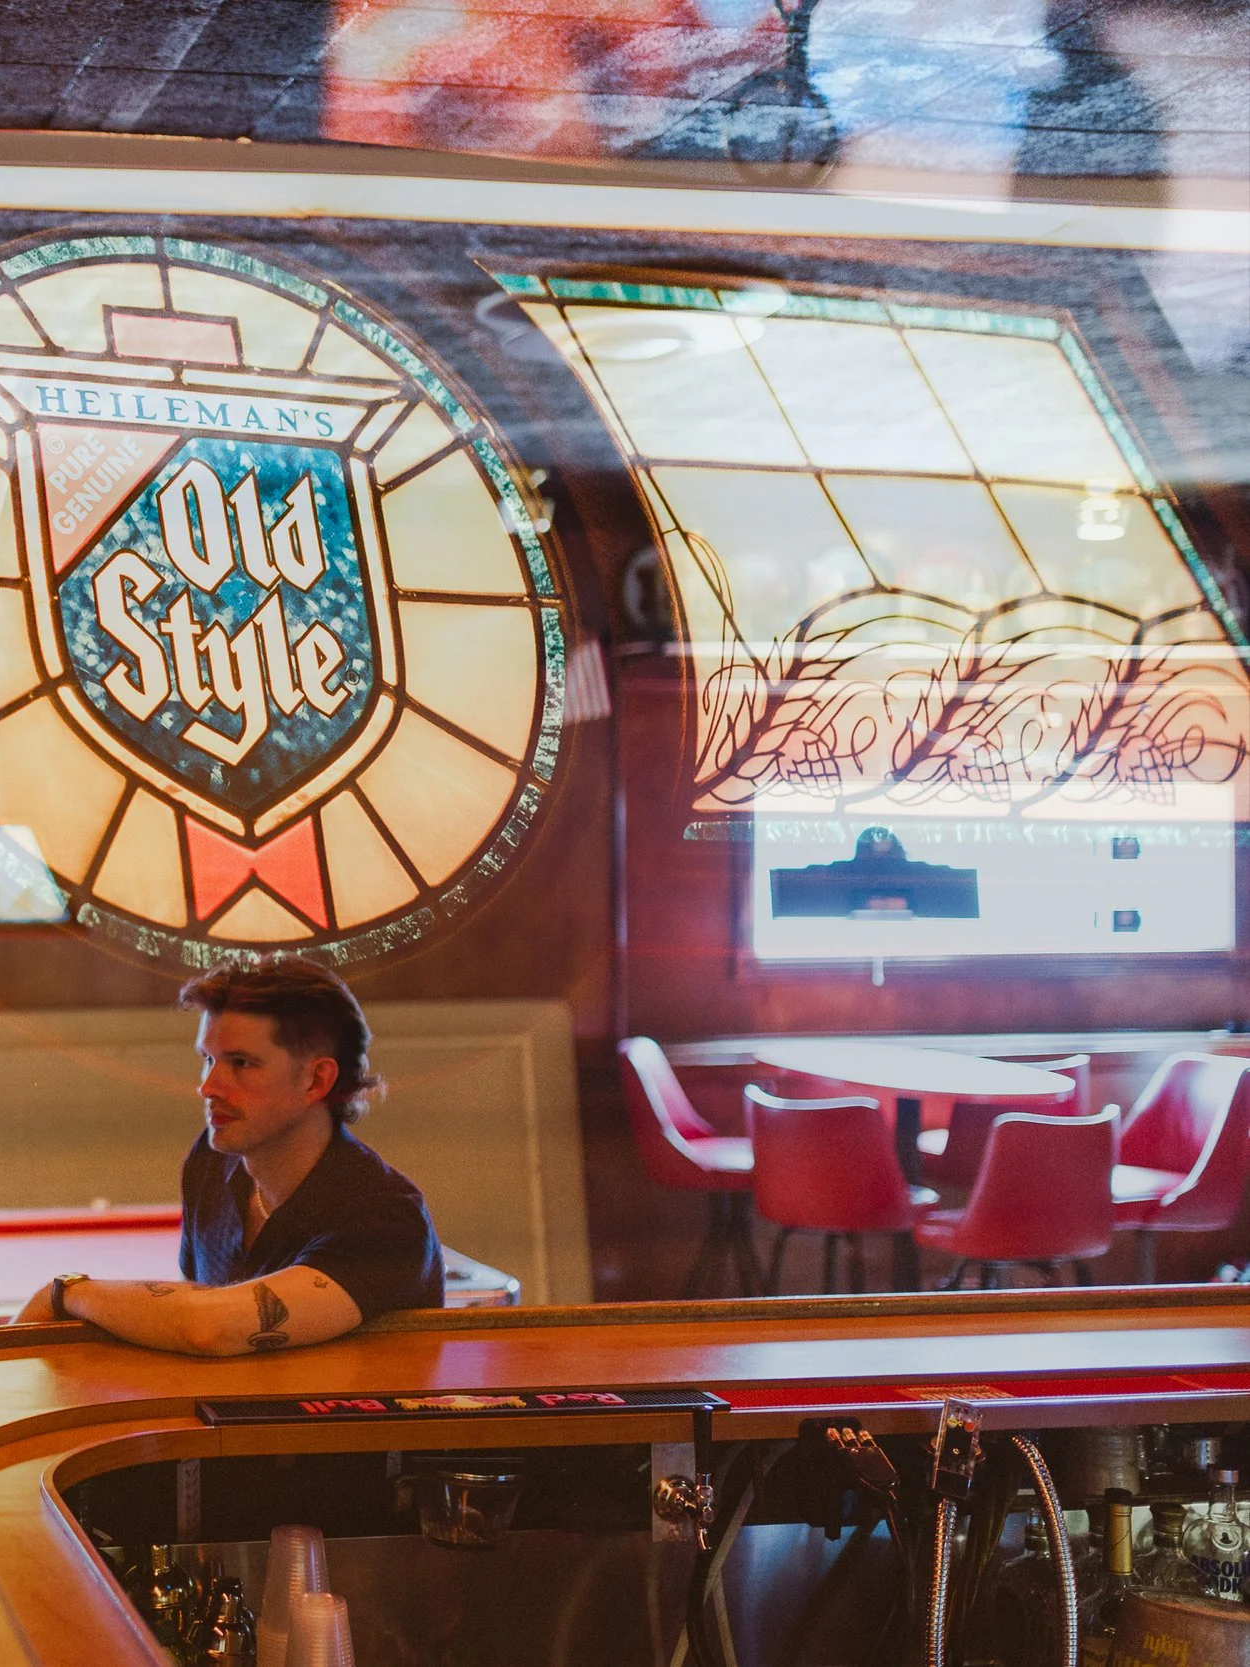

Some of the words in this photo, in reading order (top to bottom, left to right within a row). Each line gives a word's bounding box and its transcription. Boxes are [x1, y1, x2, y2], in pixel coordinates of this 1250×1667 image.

[35, 384, 337, 438] HEILEMAN'S
[48, 432, 106, 494] PURE
[52, 433, 144, 535] GENUINE
[156, 457, 327, 593] Old
[91, 547, 352, 767] Style
[298, 1399, 388, 1416] Bull
[534, 1392, 627, 1408] Red
